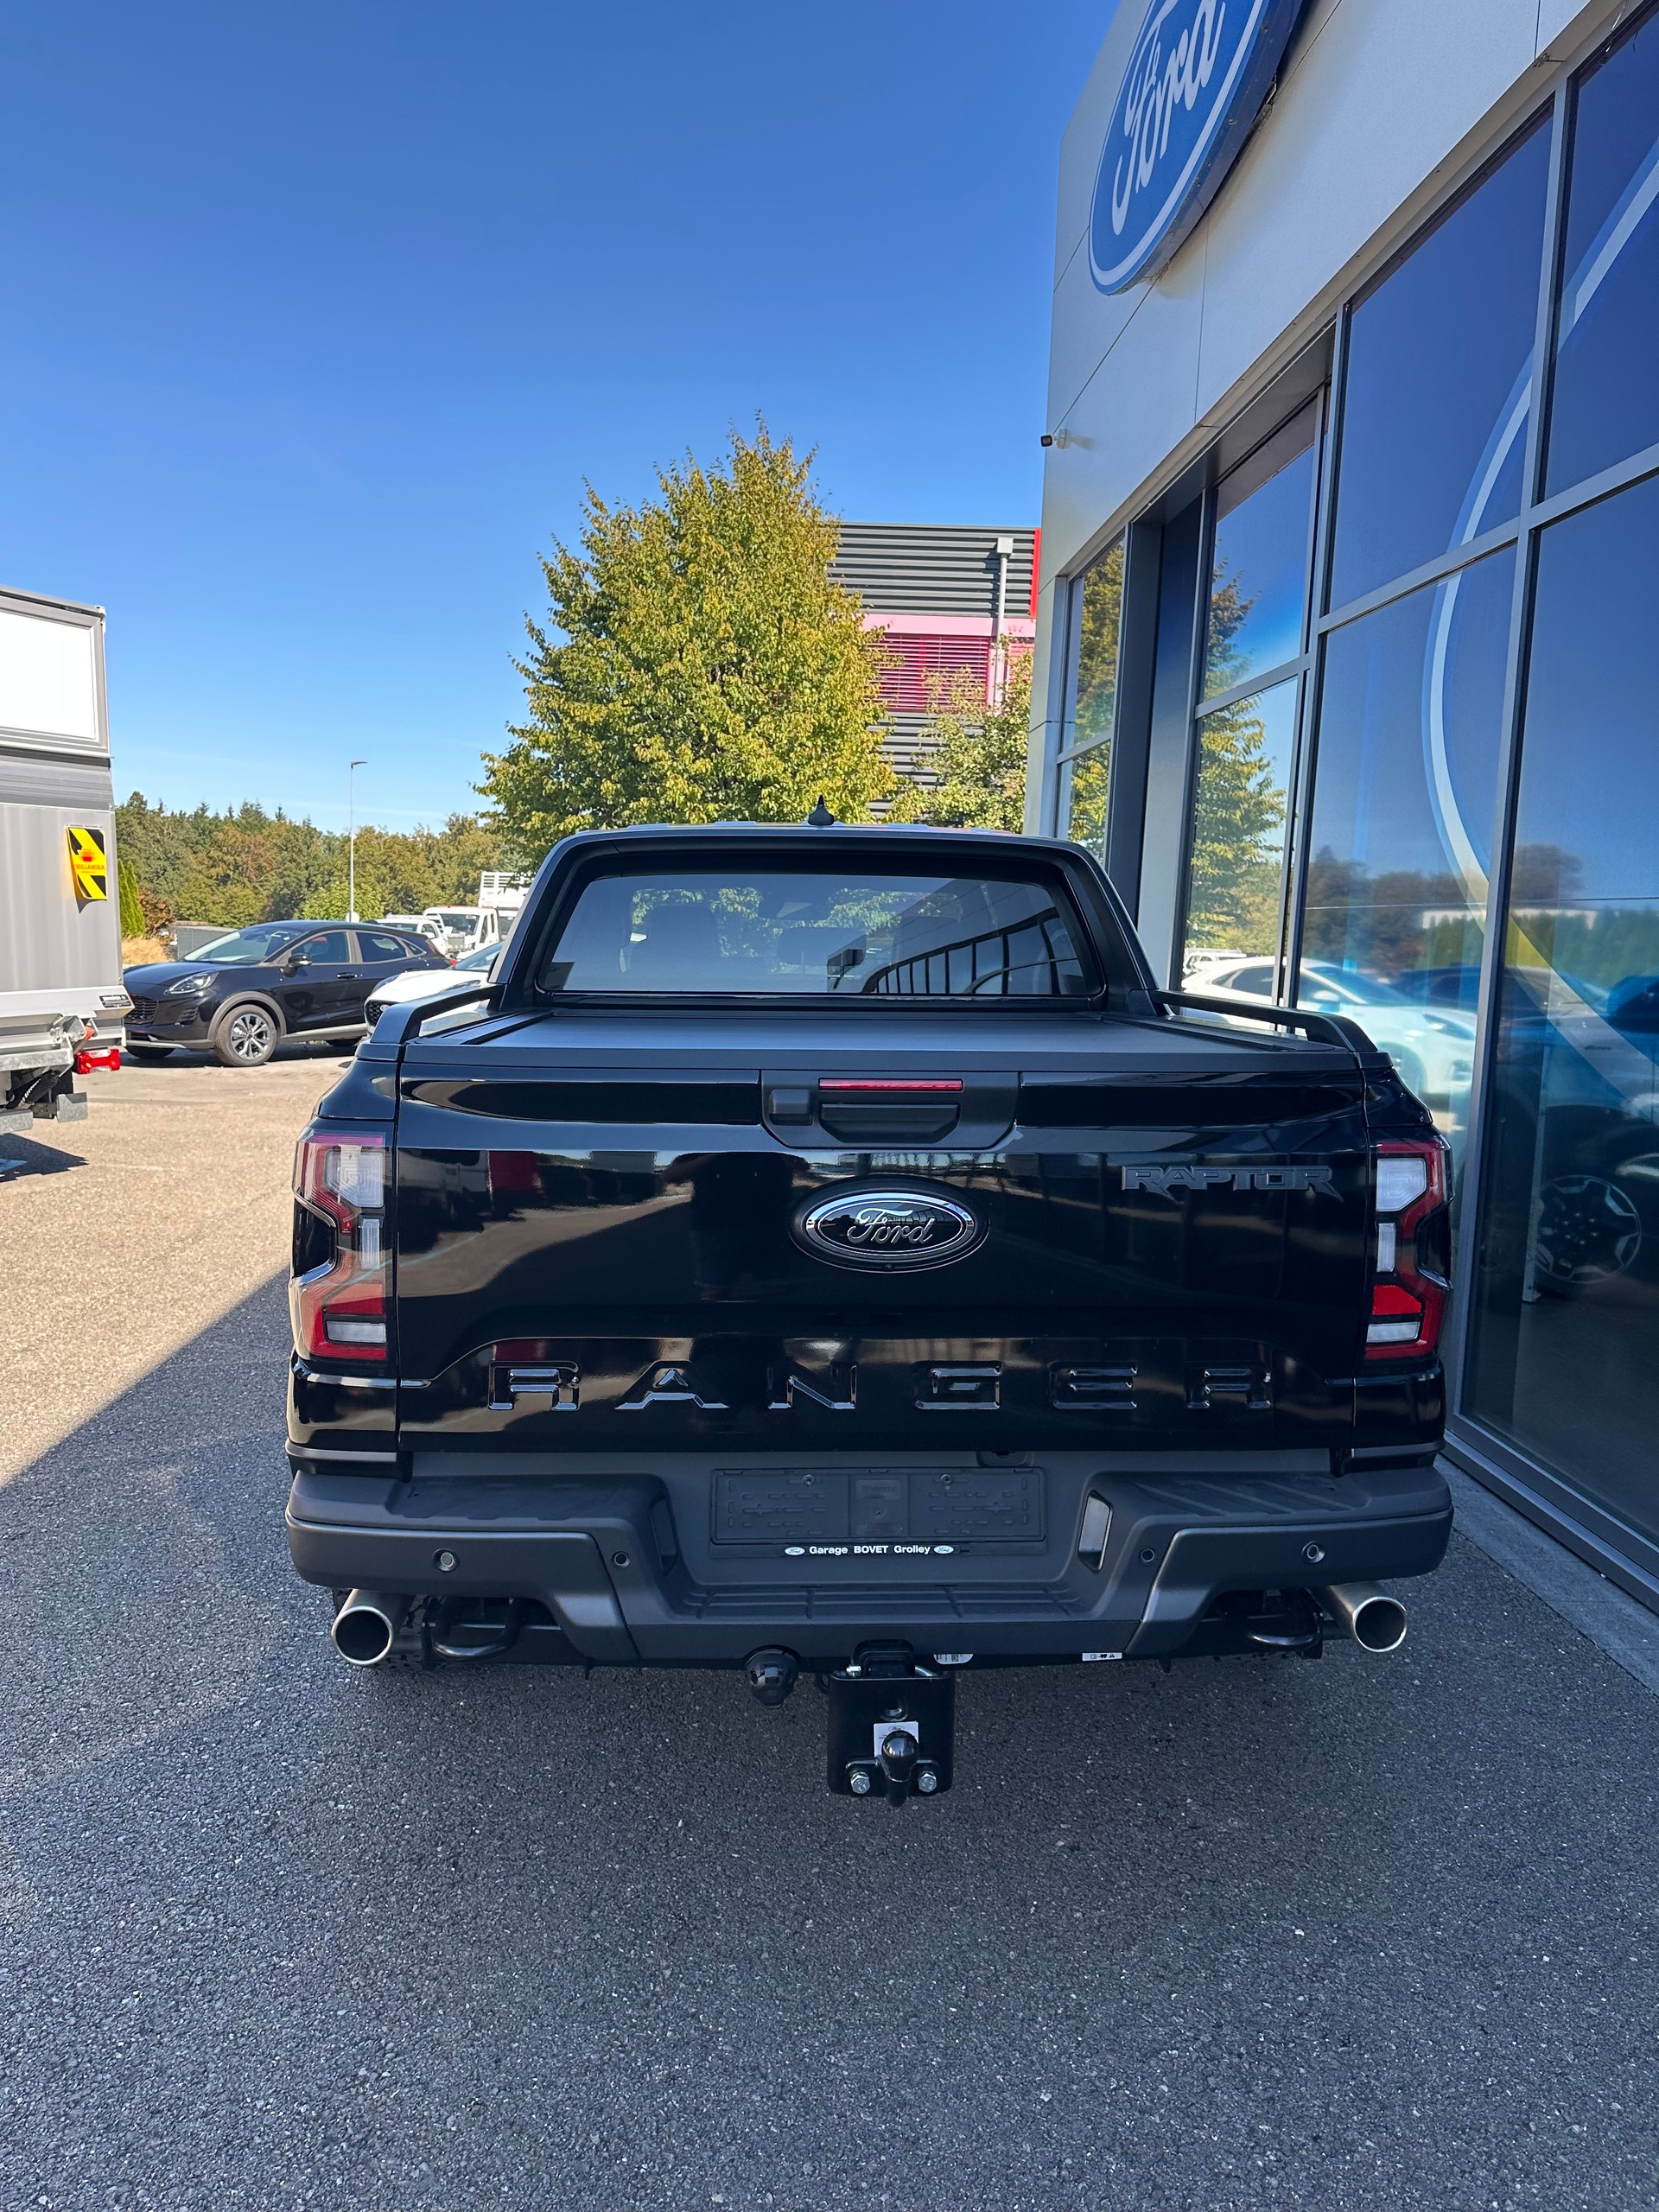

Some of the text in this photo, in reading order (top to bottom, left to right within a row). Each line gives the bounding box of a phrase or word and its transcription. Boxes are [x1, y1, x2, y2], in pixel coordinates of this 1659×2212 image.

[1111, 0, 1226, 235] Ford
[1122, 1166, 1344, 1202] RAPTOR
[847, 1208, 935, 1243] Ford
[487, 1360, 1274, 1410] RANGER
[809, 1546, 849, 1555] Garage
[854, 1545, 889, 1554] BOVET
[893, 1545, 931, 1554] Grolley
